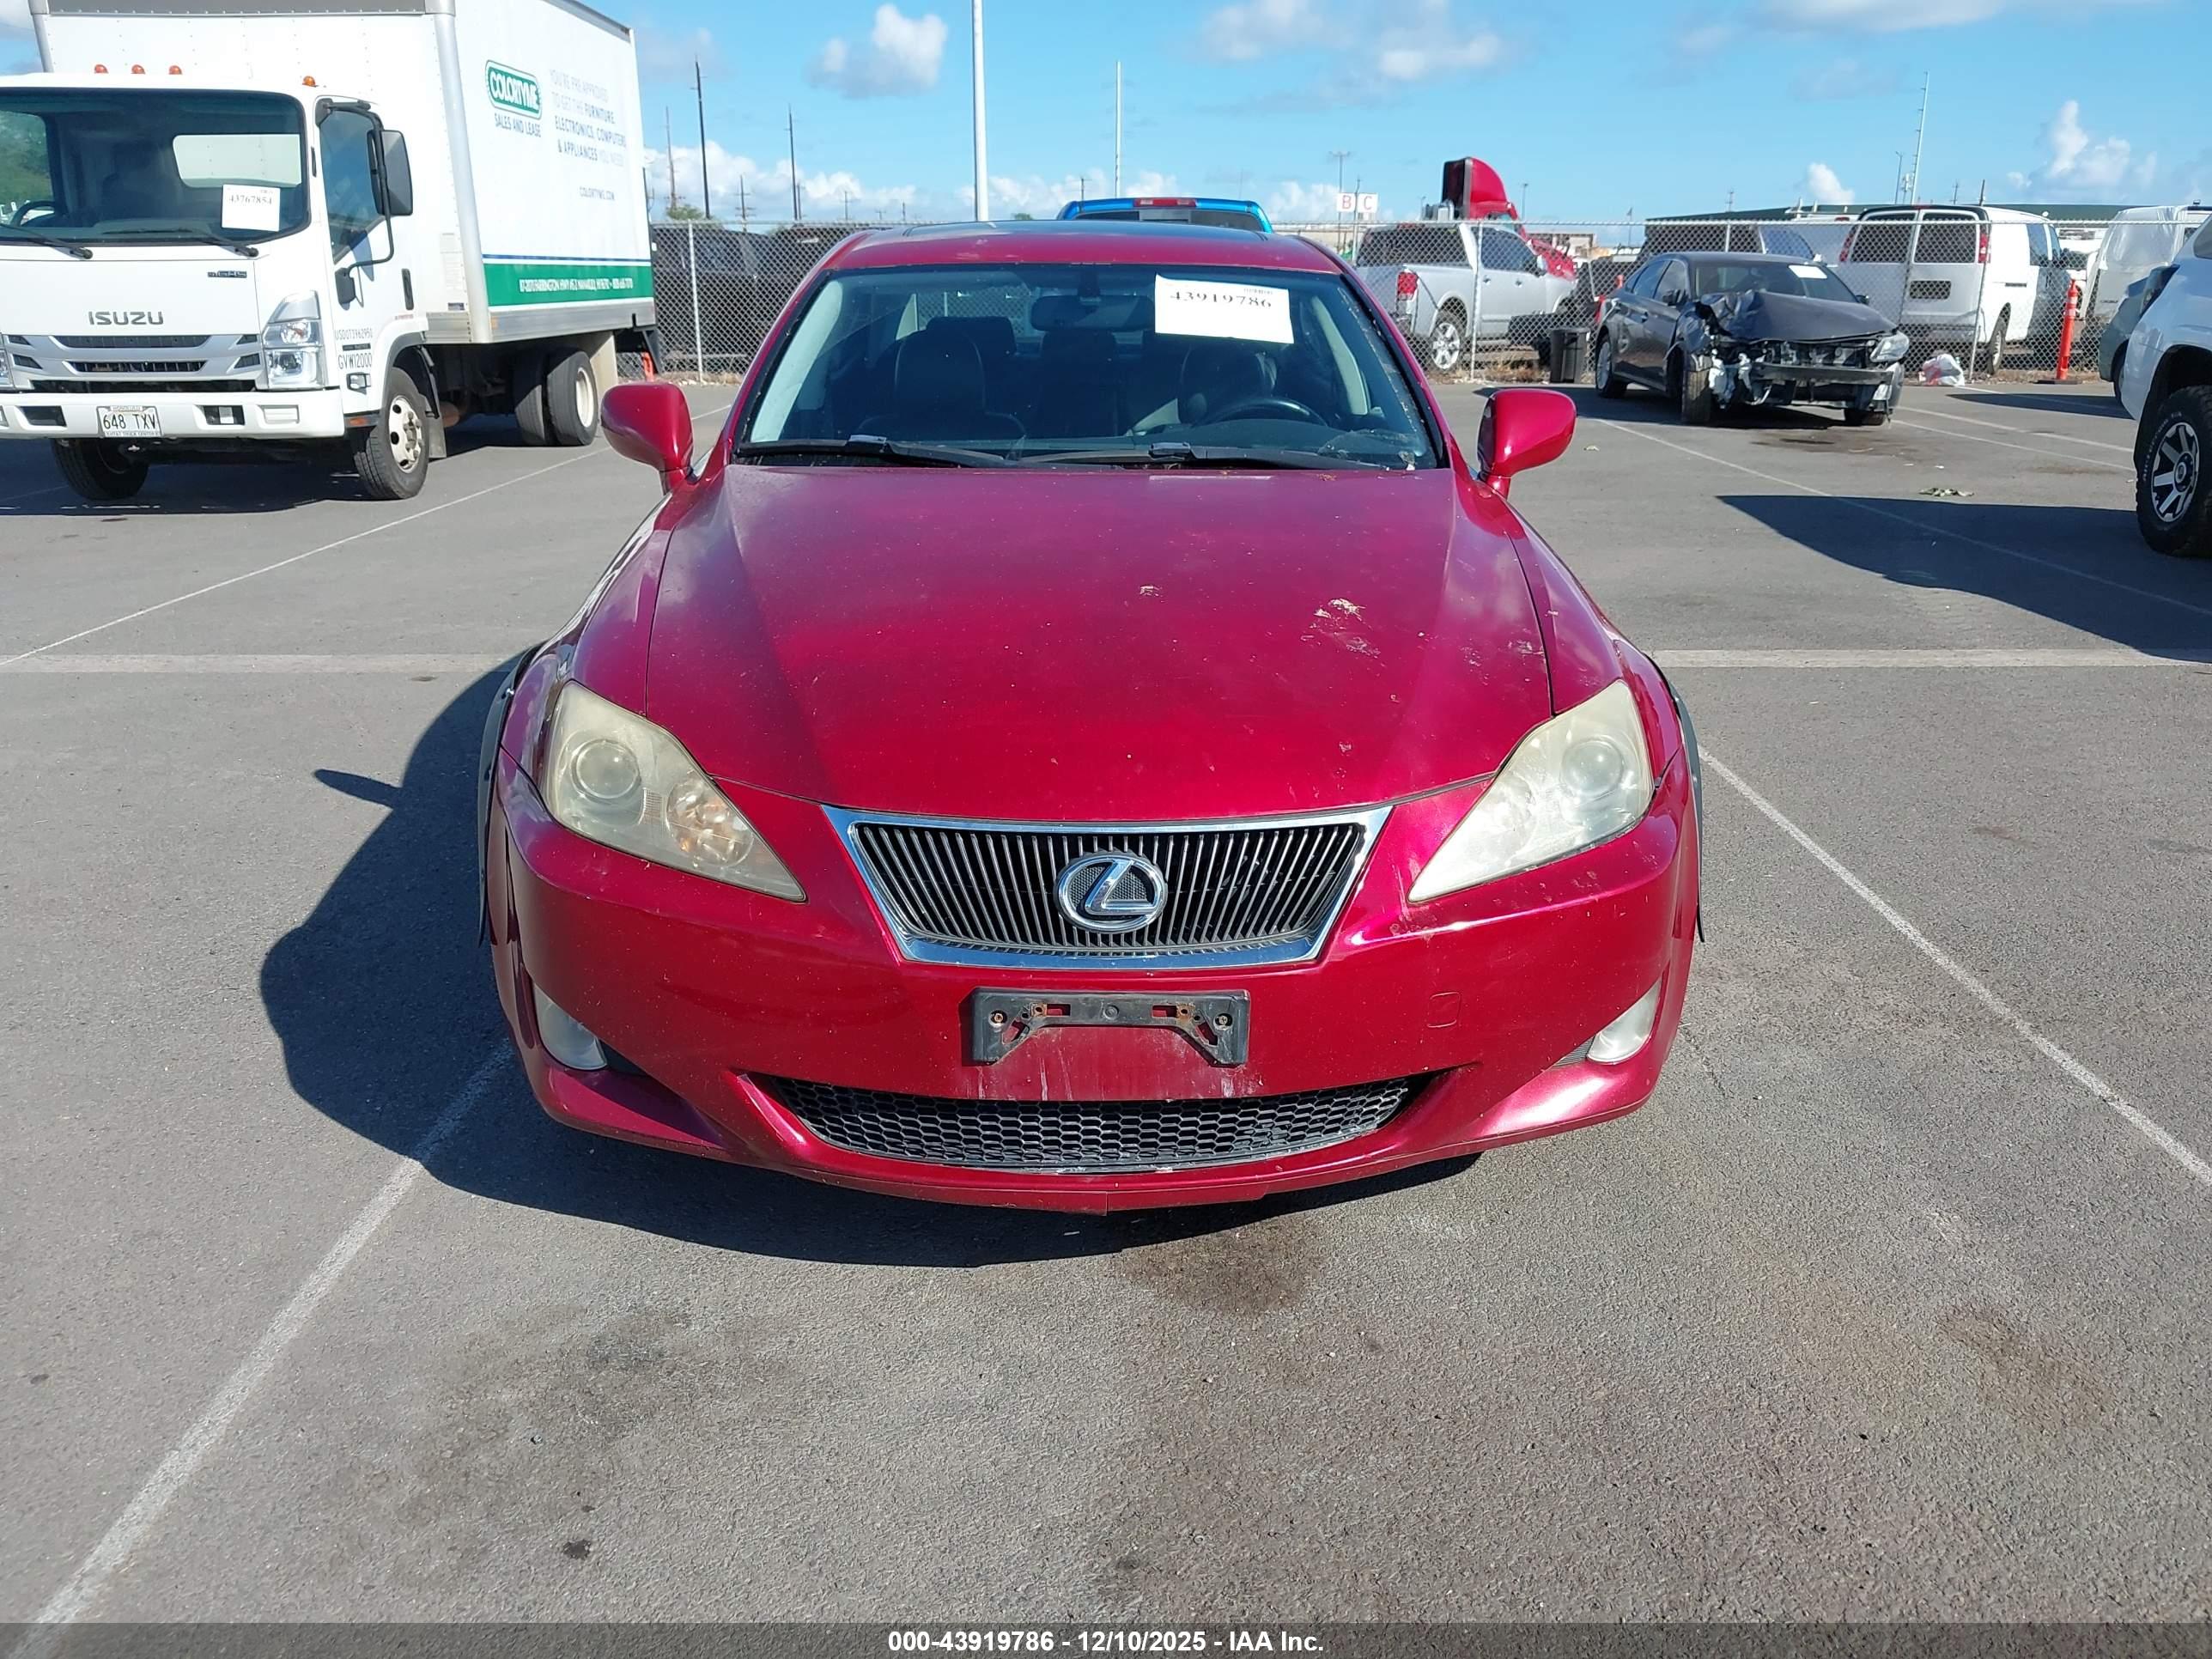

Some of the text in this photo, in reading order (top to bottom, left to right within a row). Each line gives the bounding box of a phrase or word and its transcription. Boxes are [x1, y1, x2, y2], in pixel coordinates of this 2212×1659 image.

[489, 70, 539, 110] COLORTYME
[494, 112, 542, 138] SALES AND LEASE
[563, 141, 599, 161] APPLIANCES
[1341, 194, 1352, 210] B
[1364, 195, 1373, 210] C
[1170, 290, 1273, 307] 43919786
[88, 310, 164, 326] ISUZU
[103, 413, 156, 430] 648 TXV
